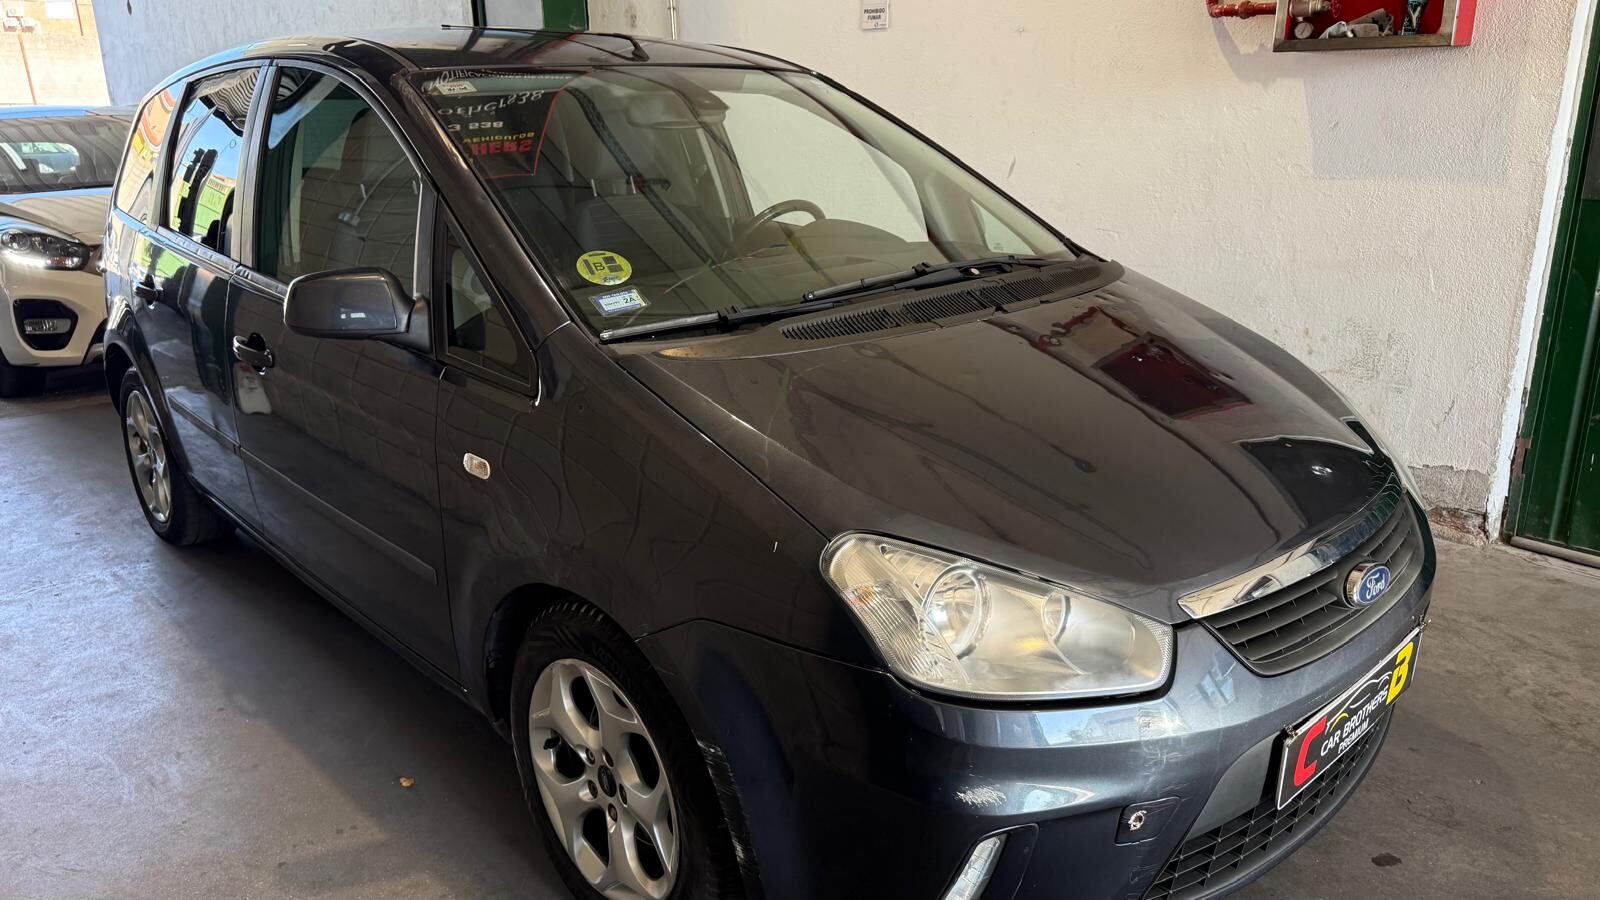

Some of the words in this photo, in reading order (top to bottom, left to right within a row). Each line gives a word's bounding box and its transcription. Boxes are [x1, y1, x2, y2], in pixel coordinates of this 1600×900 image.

[592, 262, 606, 271] B
[1366, 572, 1386, 599] Ford
[1320, 729, 1341, 757] CAR
[1342, 689, 1388, 738] BROTHERS
[1337, 717, 1370, 754] PREMIUM
